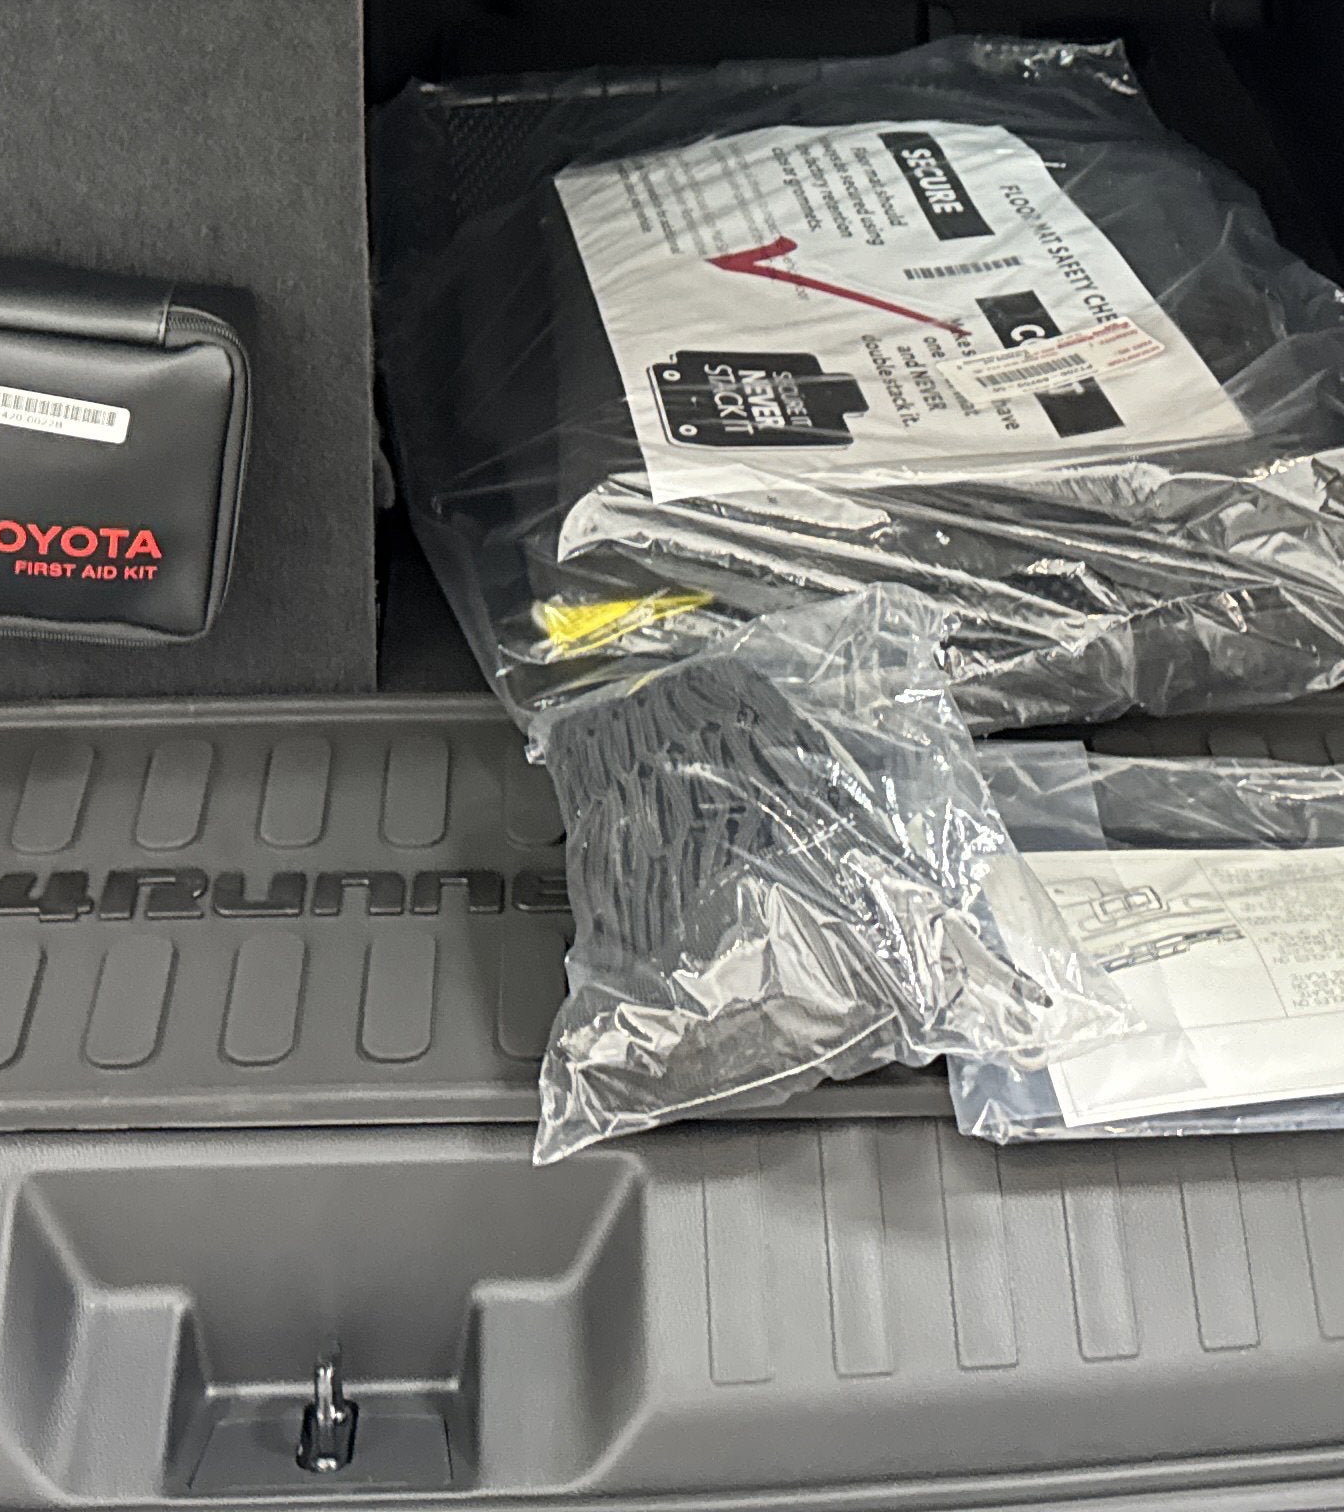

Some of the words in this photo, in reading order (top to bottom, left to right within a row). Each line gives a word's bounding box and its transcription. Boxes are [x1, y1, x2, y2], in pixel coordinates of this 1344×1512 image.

[899, 147, 966, 214] SECURE
[839, 175, 875, 215] secured
[860, 216, 886, 245] using
[874, 190, 909, 226] should
[1047, 246, 1099, 292] SAFETY
[1083, 293, 1119, 325] CHE
[895, 344, 925, 367] and
[921, 336, 946, 358] one
[702, 363, 747, 417] STACK
[860, 334, 898, 376] double
[882, 377, 915, 410] stack
[909, 370, 948, 411] NEVER
[736, 369, 786, 430] NEVER
[990, 398, 1022, 430] have
[721, 418, 753, 434] IT
[15, 560, 76, 578] FIRST
[81, 564, 117, 580] AID
[124, 566, 157, 580] KIT
